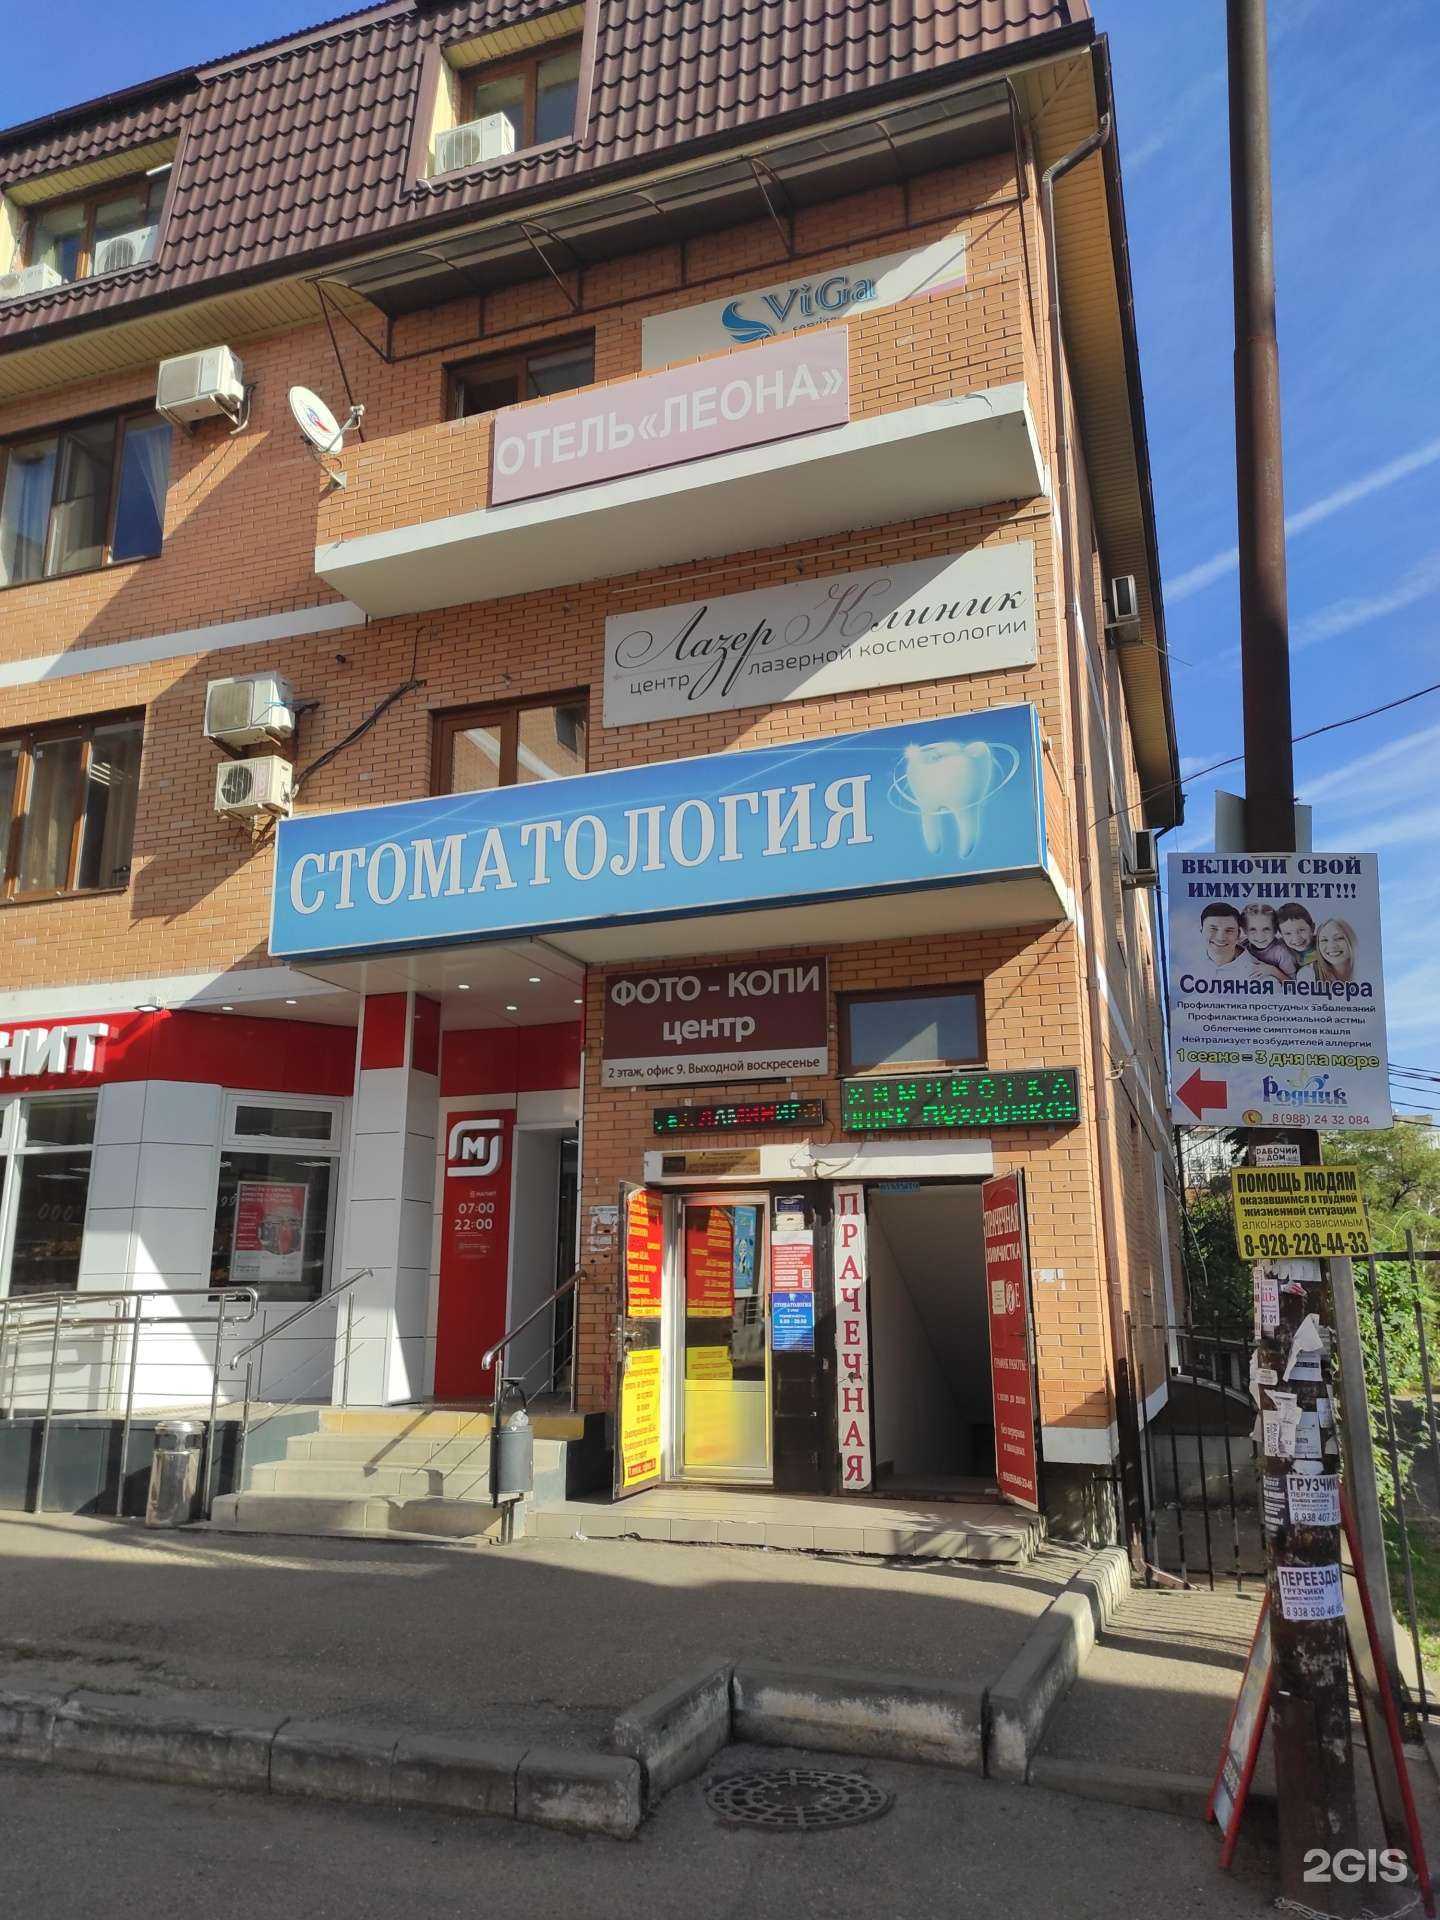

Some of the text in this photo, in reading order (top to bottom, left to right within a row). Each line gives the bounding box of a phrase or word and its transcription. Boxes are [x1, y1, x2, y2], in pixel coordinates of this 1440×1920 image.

[615, 578, 1026, 701] Лазер Клиник
[630, 620, 1027, 695] центр лазерной косметологии
[290, 775, 874, 915] СТОМАТОЛОГИЯ
[1181, 856, 1362, 875] ВКЛЮЧИ СВОЙ
[1187, 882, 1356, 899] ИММУНИТЕТ!!!
[611, 976, 701, 1006] ФОТО
[728, 966, 820, 997] КОПИ
[1180, 974, 1373, 1002] Соляная пещера
[1177, 1001, 1376, 1013] Профилактика простудных заболеваний
[1188, 1012, 1259, 1023] Профилактика
[1260, 1014, 1333, 1025] бронхиальной
[663, 1016, 755, 1044] центр
[1202, 1024, 1351, 1036] Облегчение симптомов кашля
[1182, 1036, 1372, 1049] Нейтрализует возбудителей аллергии
[608, 1057, 820, 1078] 2 этаж, офис 9. Выходной воскресенье
[1177, 1048, 1185, 1062] 1
[1186, 1051, 1240, 1064] сеанс
[1255, 1050, 1267, 1064] 3
[1269, 1053, 1305, 1067] дня
[1307, 1054, 1329, 1066] на
[1332, 1055, 1380, 1071] море
[1314, 1115, 1328, 1124] 24
[1331, 1116, 1345, 1125] 32
[1348, 1116, 1370, 1125] 084
[1237, 1171, 1357, 1195] ПОМОЩЬ ЛЮДЯМ
[458, 1202, 495, 1215] 07:00
[1240, 1193, 1358, 1206] оказавшимся в трудной
[1243, 1206, 1357, 1217] жизненной ситуации
[454, 1218, 493, 1231] 22:00
[1304, 1218, 1363, 1229] зависимым
[1243, 1231, 1369, 1257] 8-928-228-44-33
[838, 1192, 865, 1483] ПРАЧЕЧНАЯ
